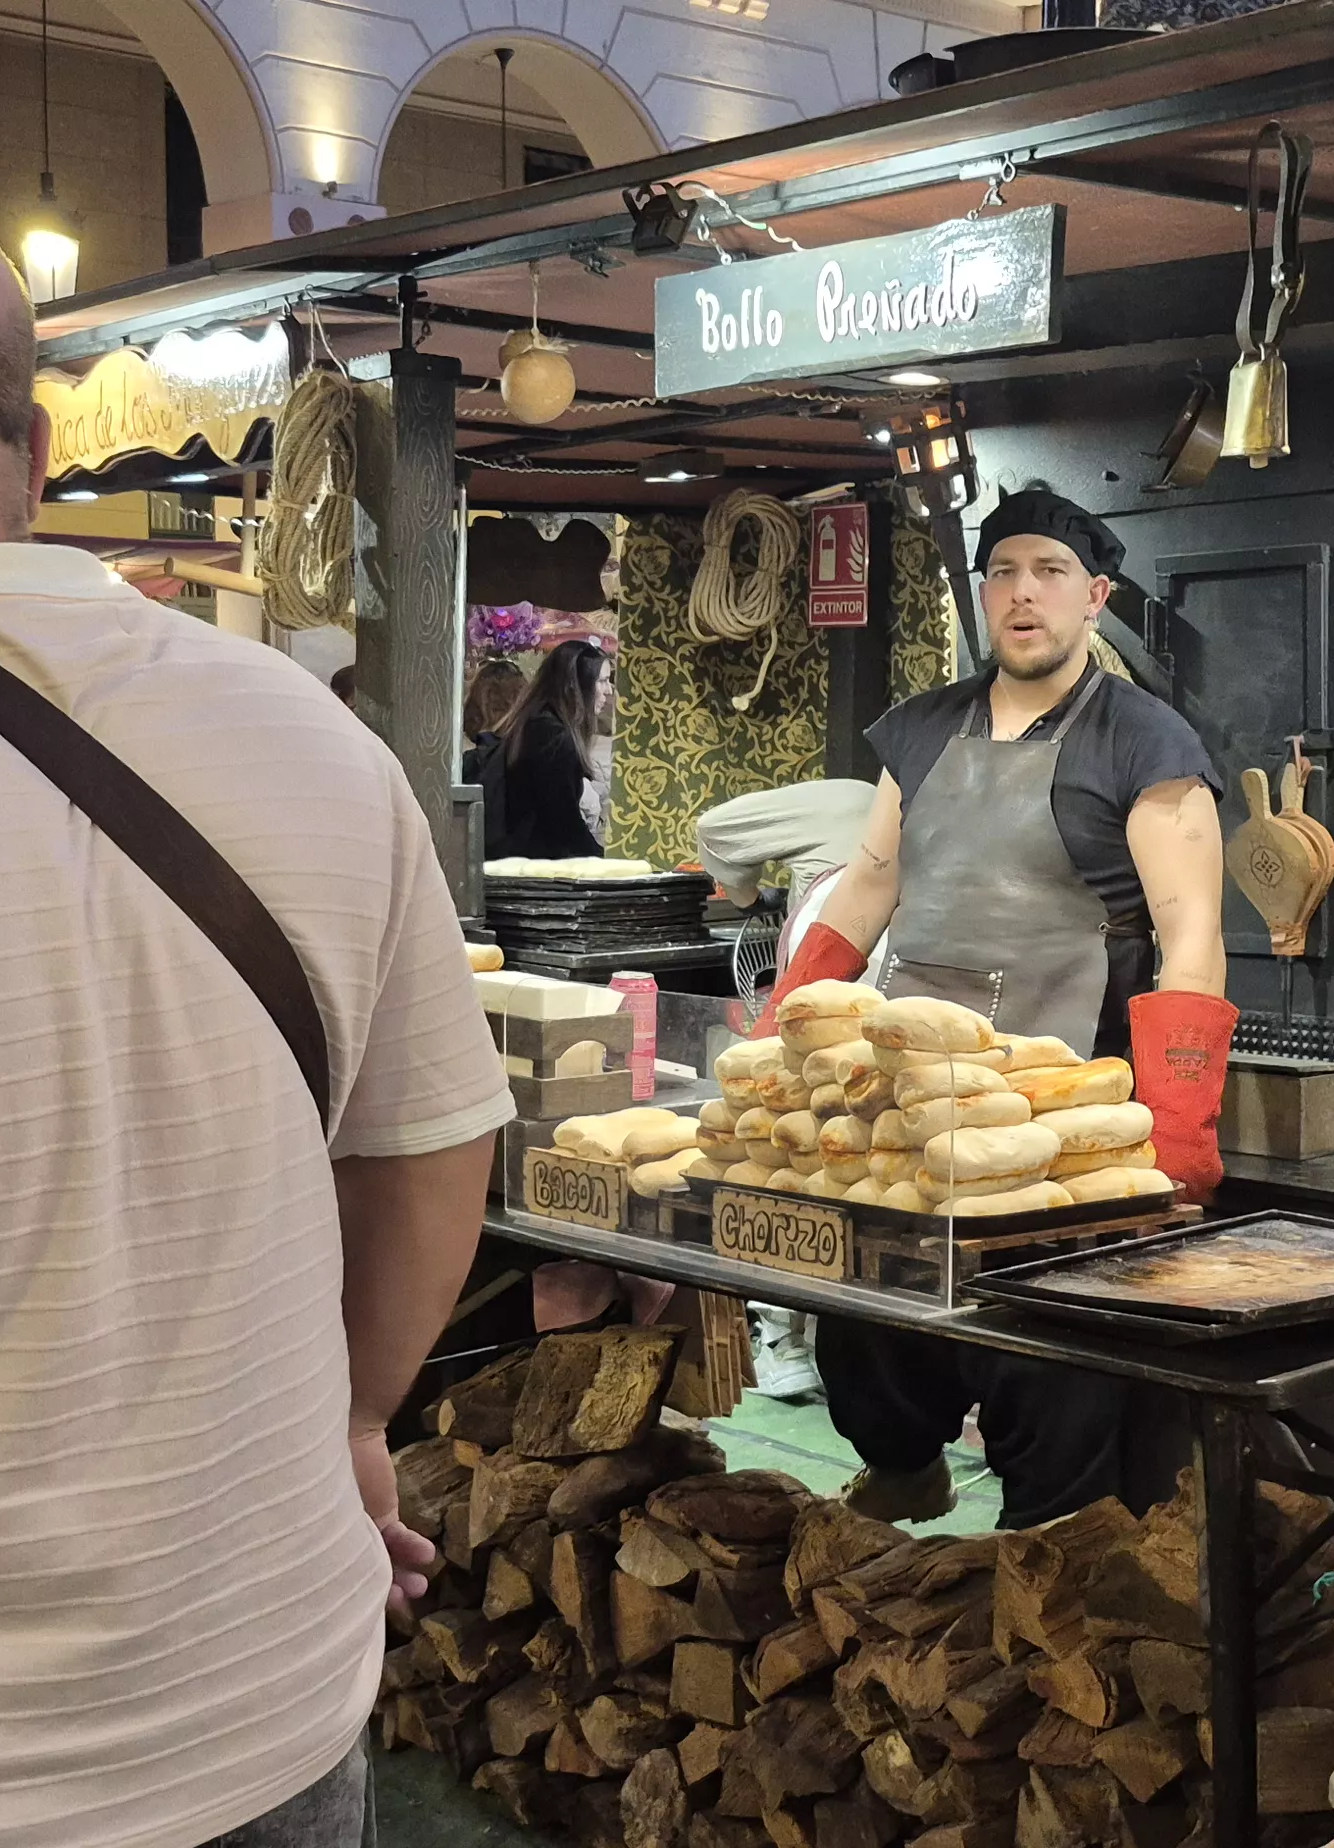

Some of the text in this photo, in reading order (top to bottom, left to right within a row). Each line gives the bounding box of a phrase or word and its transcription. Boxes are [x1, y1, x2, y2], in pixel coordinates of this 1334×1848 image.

[695, 251, 980, 354] Bollo Preñado
[95, 379, 117, 450] de
[813, 600, 863, 615] EXTINTOR
[533, 1160, 609, 1219] Bacon
[719, 1203, 838, 1267] Chorizo
